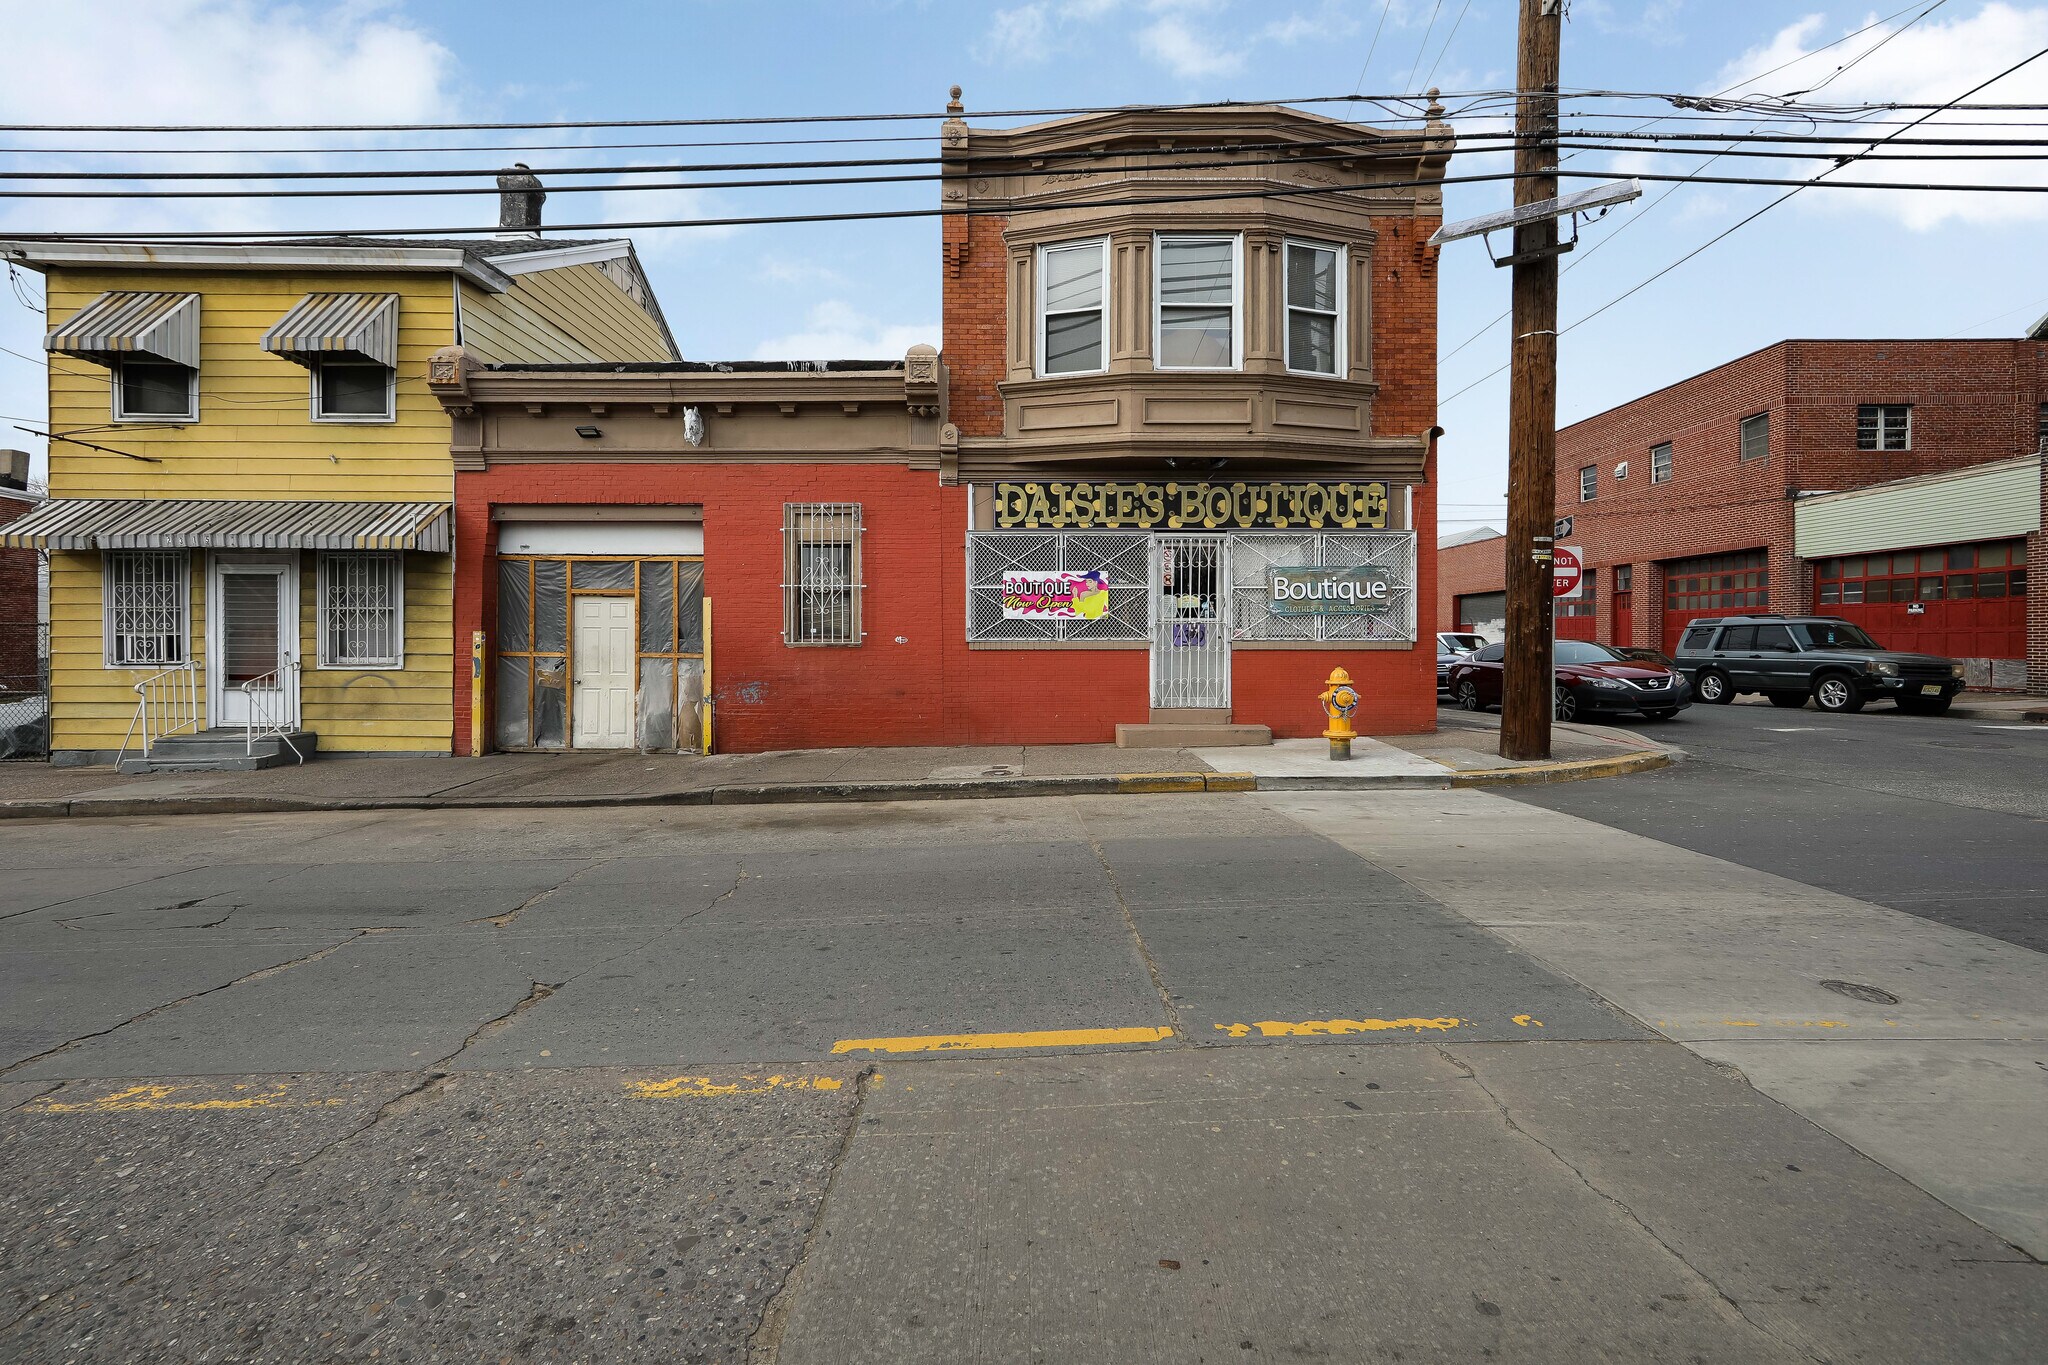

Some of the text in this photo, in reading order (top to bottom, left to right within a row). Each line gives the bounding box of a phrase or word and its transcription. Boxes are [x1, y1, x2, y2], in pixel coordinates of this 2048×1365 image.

[997, 485, 1385, 524] DAISIES BOUTIQUE
[1554, 557, 1573, 565] NOT
[1005, 581, 1071, 597] BOUTIQUE
[1273, 576, 1387, 605] Boutique
[1003, 595, 1073, 611] Now Open
[1284, 605, 1316, 613] CLOTHES
[1328, 604, 1376, 612] ACCESSORIES
